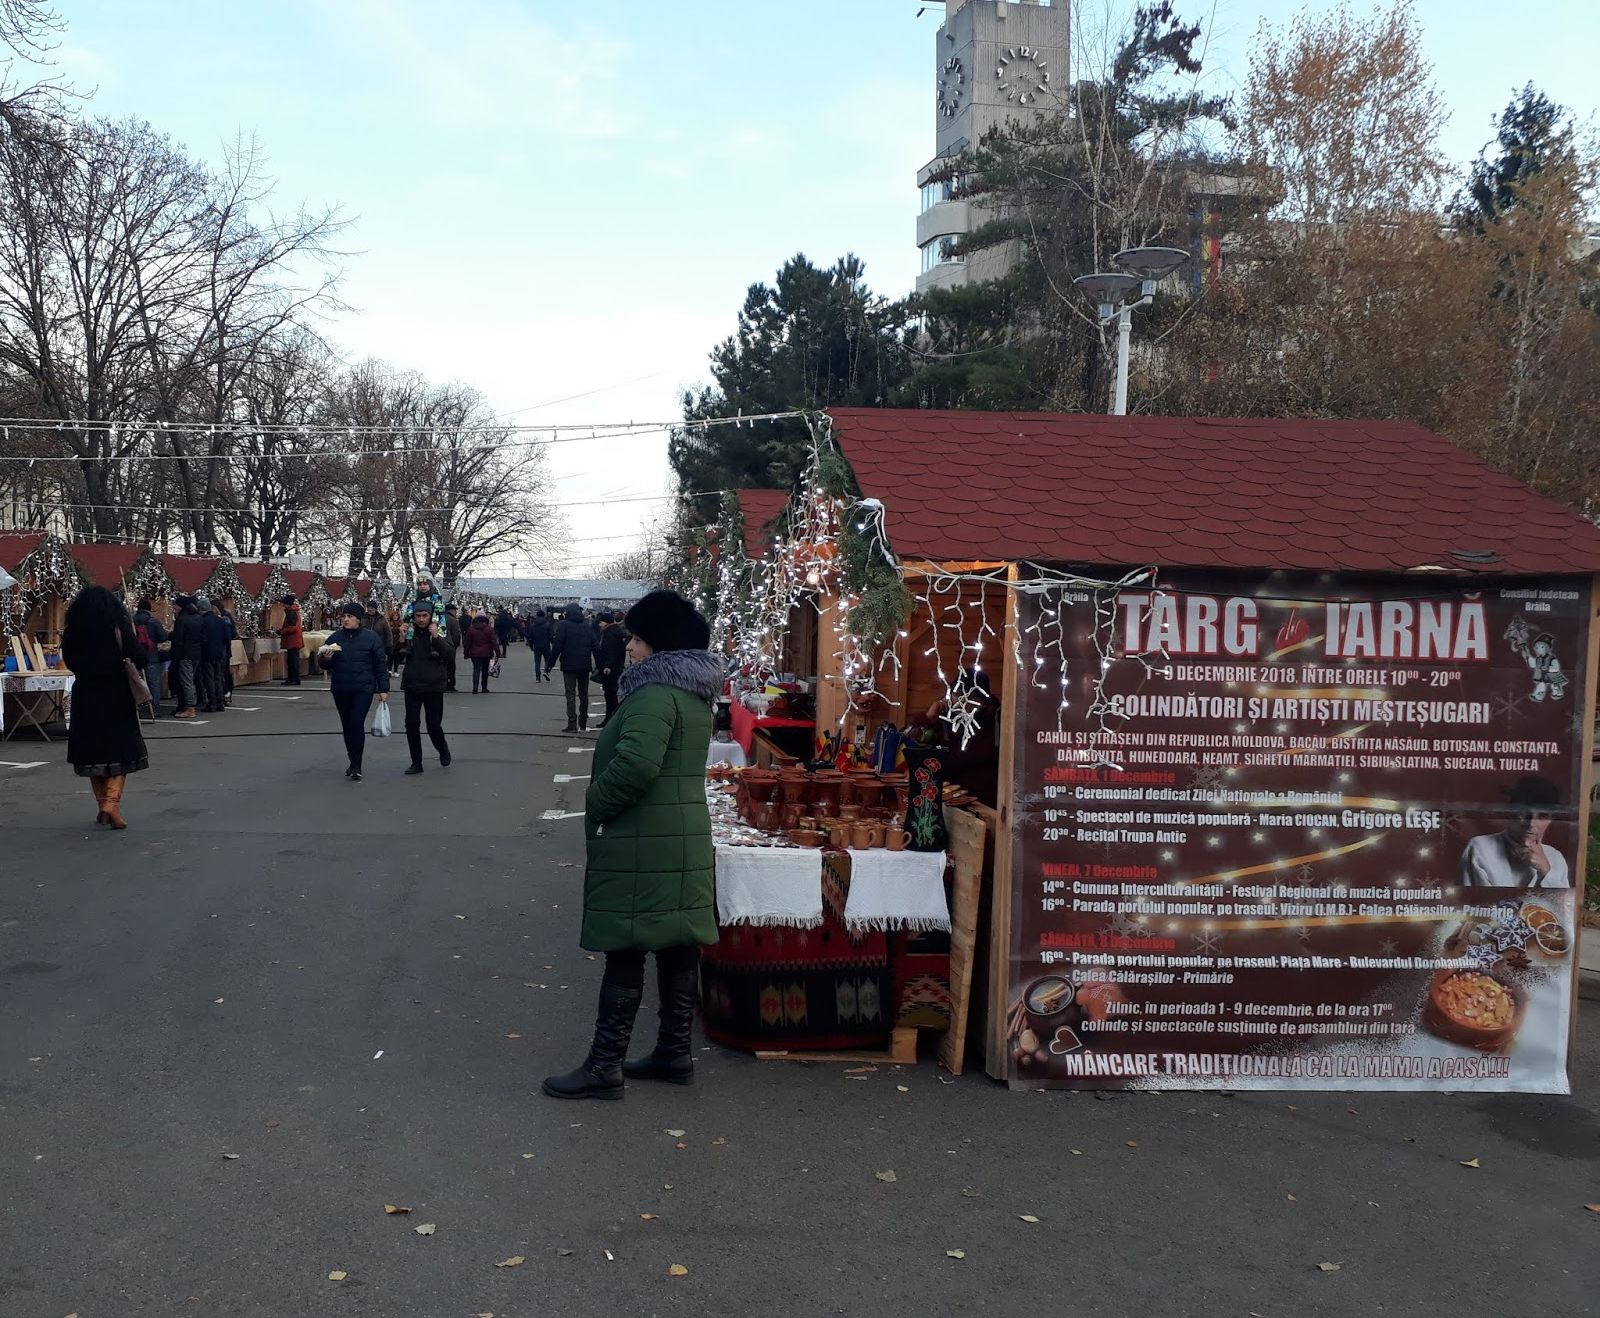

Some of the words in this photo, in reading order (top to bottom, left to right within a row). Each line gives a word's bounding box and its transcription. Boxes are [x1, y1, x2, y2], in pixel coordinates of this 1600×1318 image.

[1020, 46, 1029, 57] 12
[1118, 584, 1257, 654] TÂRG
[1325, 592, 1488, 659] IARNĂ
[1164, 665, 1173, 681] 9
[1177, 665, 1257, 682] DECEMBRIE
[1260, 666, 1299, 684] 2018,
[1302, 664, 1342, 685] ÎNTRE
[1346, 669, 1387, 686] ORELE
[1111, 691, 1243, 719] COLINDĂTORI
[1248, 697, 1267, 723] ȘI
[1272, 697, 1348, 726] ARTIȘTI
[1354, 700, 1490, 728] MEȘTEȘUGARI
[1037, 731, 1072, 744] CAHUL
[1076, 732, 1088, 747] ȘI
[1147, 733, 1166, 746] DIN
[1169, 733, 1229, 747] REPUBLICA
[1232, 735, 1287, 749] MOLDOVA,
[1331, 737, 1381, 753] BISTRIȚA
[1494, 741, 1561, 757] CONSTANȚA,
[1129, 750, 1200, 766] HUNEDOARA,
[1245, 753, 1290, 766] SIGHETU
[1444, 757, 1496, 770] SUCEAVA,
[1499, 758, 1539, 772] TULCEA
[1075, 786, 1143, 800] Ceremonial
[1146, 788, 1190, 801] dedicat
[1192, 789, 1218, 801] Zilei
[1287, 790, 1343, 804] României
[1076, 810, 1134, 824] Spectacol
[1136, 811, 1151, 823] de
[1153, 812, 1195, 824] muzică
[1197, 812, 1251, 827] populară
[1260, 813, 1292, 826] Maria
[1294, 814, 1340, 828] CIOCAN,
[1342, 810, 1402, 829] Grigore
[1406, 809, 1440, 833] LEȘE
[1077, 828, 1119, 842] Recital
[1120, 830, 1154, 844] Trupa
[1156, 830, 1187, 843] Antic
[1073, 881, 1118, 896] Cununa
[1121, 882, 1224, 899] Interculturalității
[1232, 884, 1277, 898] Festival
[1279, 886, 1330, 900] Regional
[1333, 887, 1347, 899] de
[1350, 886, 1391, 899] muzică
[1393, 887, 1442, 901] populară
[1073, 899, 1115, 913] Parada
[1118, 900, 1165, 914] portului
[1167, 901, 1215, 916] popular,
[1217, 904, 1232, 916] pe
[1234, 902, 1279, 916] traseul:
[1280, 903, 1312, 916] Viziru
[1359, 904, 1392, 917] Calea
[1072, 952, 1115, 966] Parada
[1118, 953, 1165, 967] portului
[1217, 957, 1232, 968] pe
[1234, 954, 1279, 968] traseul:
[1280, 956, 1311, 971] Piața
[1312, 956, 1341, 969] Mare
[1350, 956, 1412, 969] Bulevardul
[1072, 969, 1106, 983] Calea
[1108, 970, 1175, 987] Călărașilor
[1183, 971, 1234, 984] Primărie
[1105, 1001, 1143, 1016] Zilnic,
[1144, 1001, 1158, 1015] în
[1160, 1002, 1216, 1016] perioada
[1234, 1003, 1242, 1015] 9
[1245, 1003, 1314, 1017] decembrie,
[1316, 1003, 1331, 1016] de
[1334, 1003, 1346, 1016] la
[1349, 1006, 1370, 1016] ora
[1081, 1019, 1128, 1032] colinde
[1131, 1020, 1143, 1035] și
[1144, 1020, 1215, 1033] spectacole
[1217, 1022, 1277, 1037] susținute
[1280, 1022, 1295, 1034] de
[1298, 1022, 1368, 1035] ansambluri
[1369, 1021, 1388, 1034] din
[1066, 1050, 1160, 1076] MÂNCARE
[1162, 1053, 1302, 1080] TRADIȚIONALĂ
[1306, 1055, 1333, 1077] CA
[1336, 1056, 1360, 1077] LA
[1364, 1056, 1424, 1078] MAMA
[1427, 1053, 1511, 1079] ACASĂ!!!
